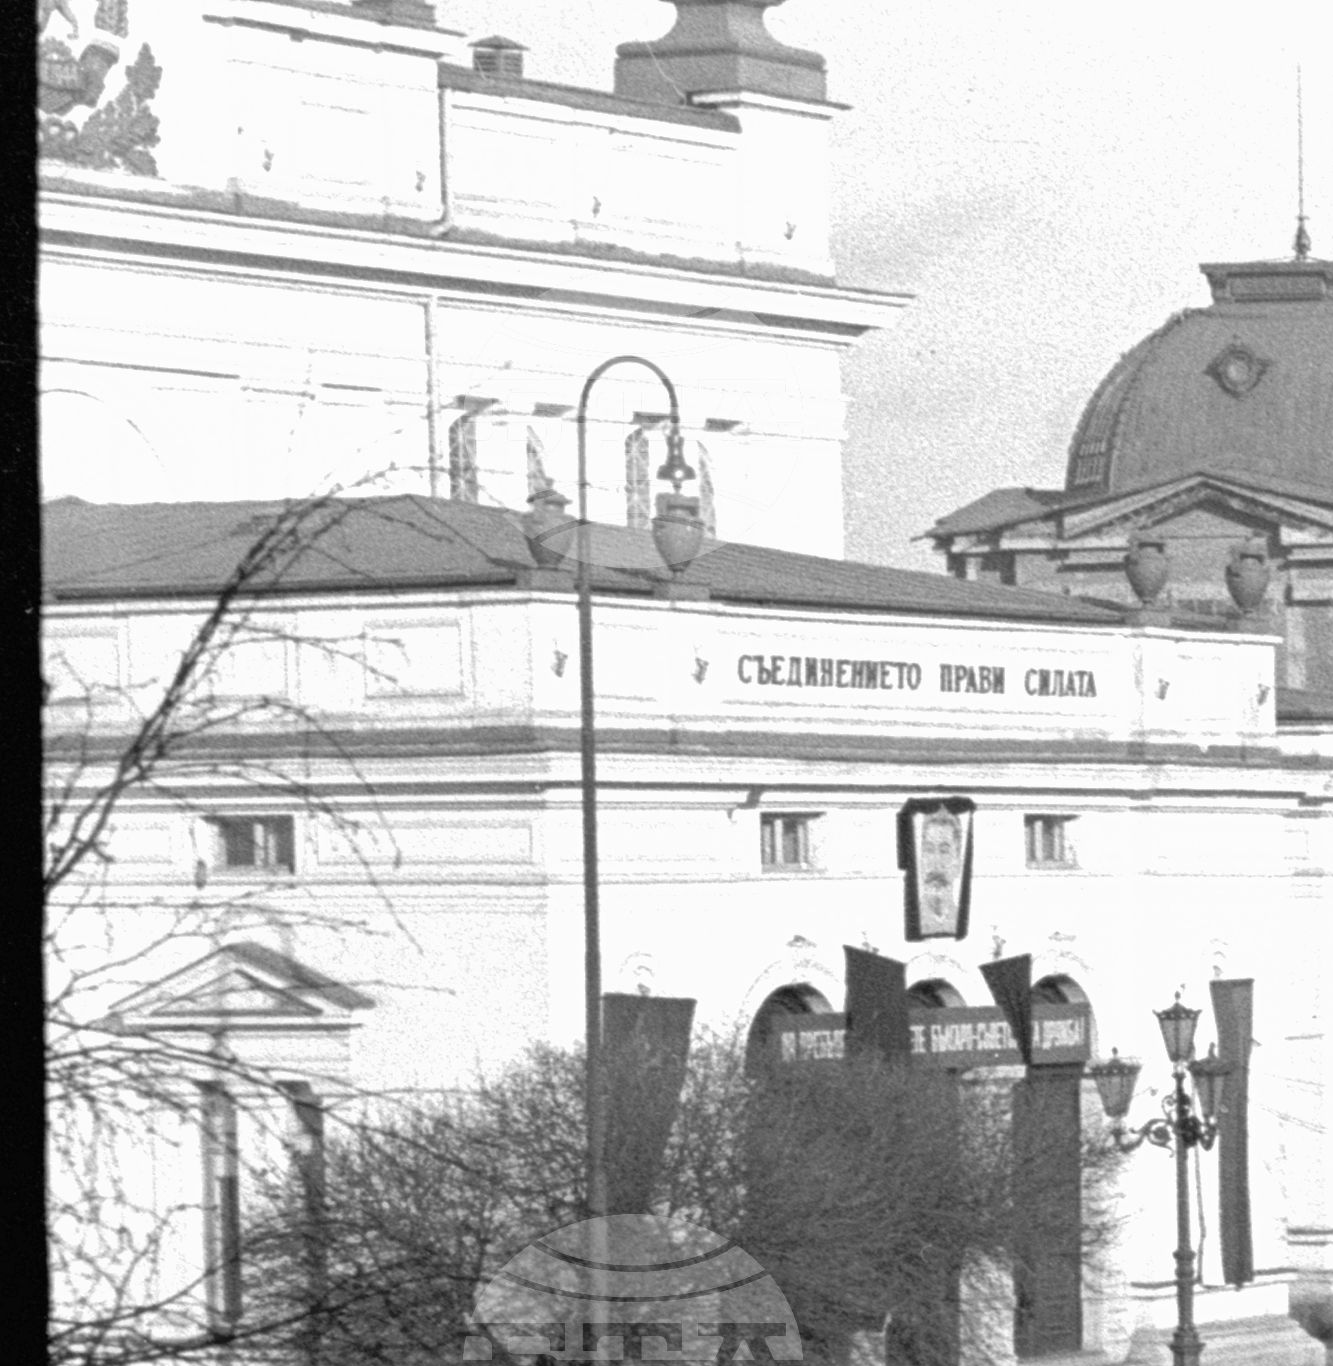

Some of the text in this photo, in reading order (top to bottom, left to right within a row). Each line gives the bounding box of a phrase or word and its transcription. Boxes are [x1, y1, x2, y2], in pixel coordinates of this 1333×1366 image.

[737, 654, 1097, 698] СЪЕДИНЕНИЕТО ПРАВИ СИЛАТА
